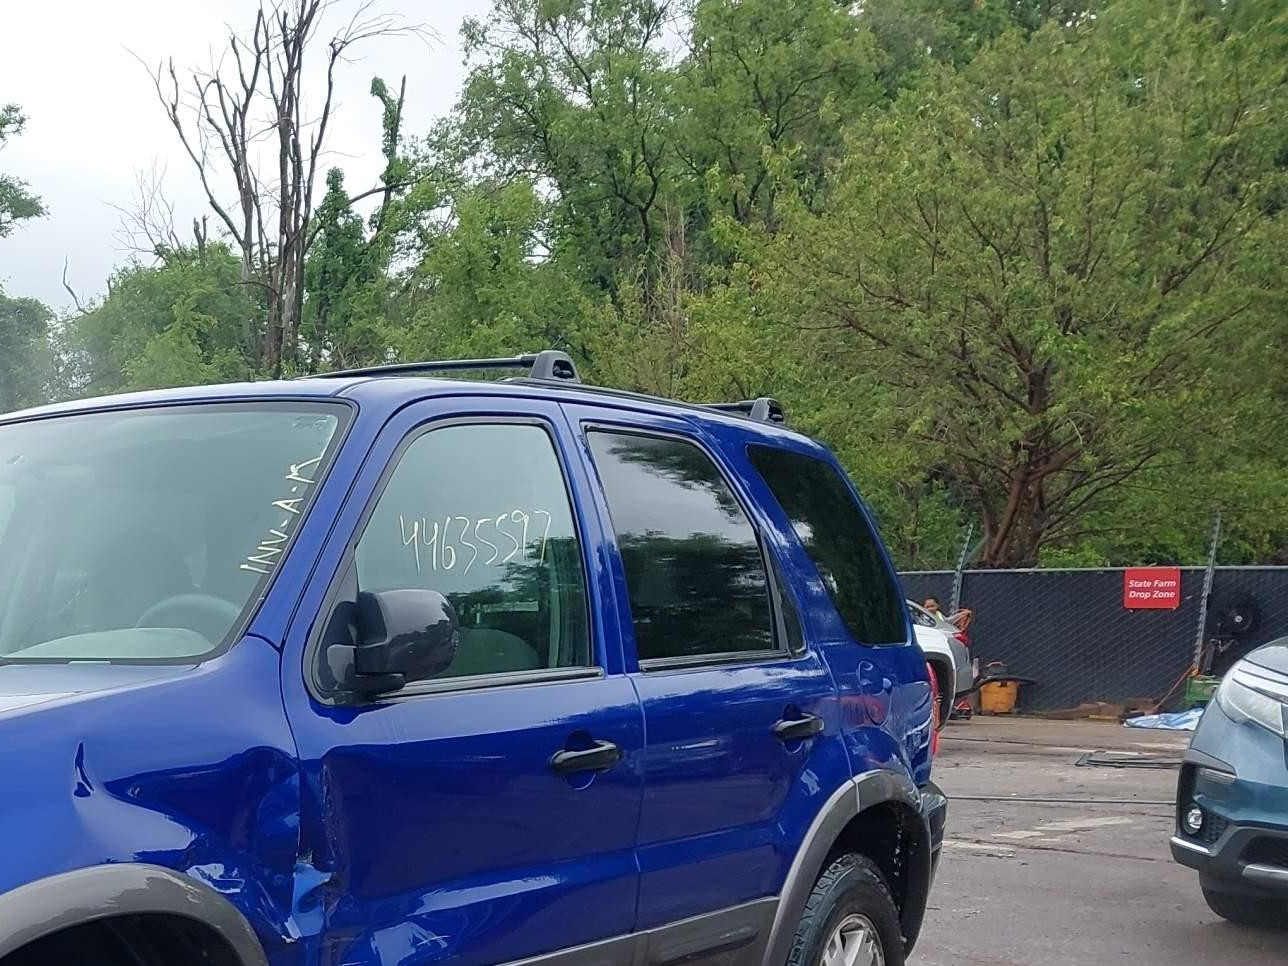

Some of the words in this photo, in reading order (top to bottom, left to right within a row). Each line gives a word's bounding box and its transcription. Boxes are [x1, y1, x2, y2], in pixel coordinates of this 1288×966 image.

[399, 509, 552, 576] 44635597
[1128, 579, 1152, 588] State
[1153, 579, 1176, 588] Farm
[1128, 590, 1151, 599] Drop
[1152, 590, 1175, 598] Zone
